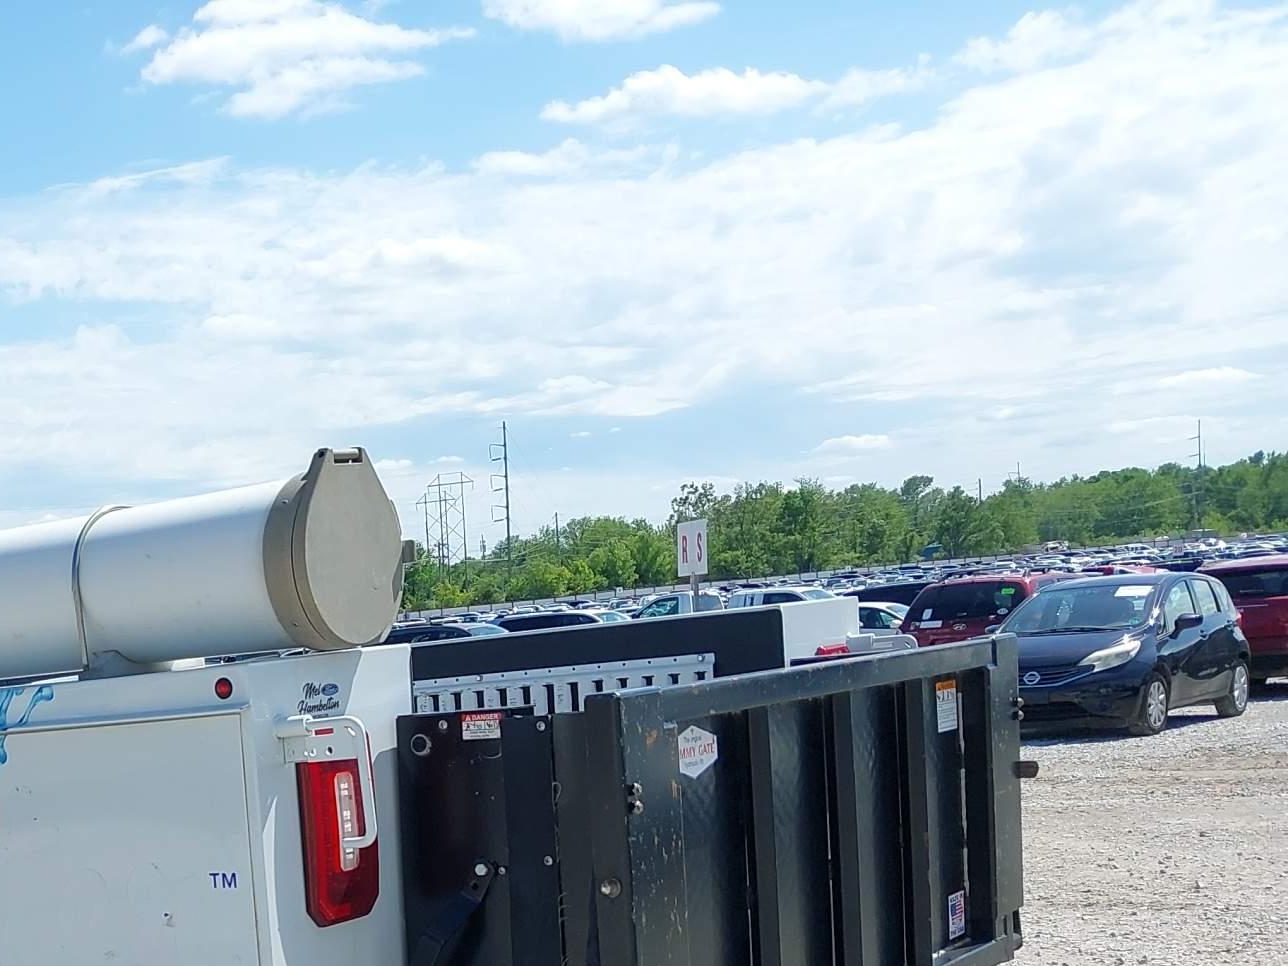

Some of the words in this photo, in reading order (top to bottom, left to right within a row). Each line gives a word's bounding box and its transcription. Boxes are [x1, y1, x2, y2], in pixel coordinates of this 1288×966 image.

[682, 535, 688, 564] R
[697, 532, 702, 562] S
[472, 713, 501, 721] DANGER
[679, 745, 696, 760] MMY
[698, 742, 715, 755] GATE
[208, 872, 237, 889] TM
